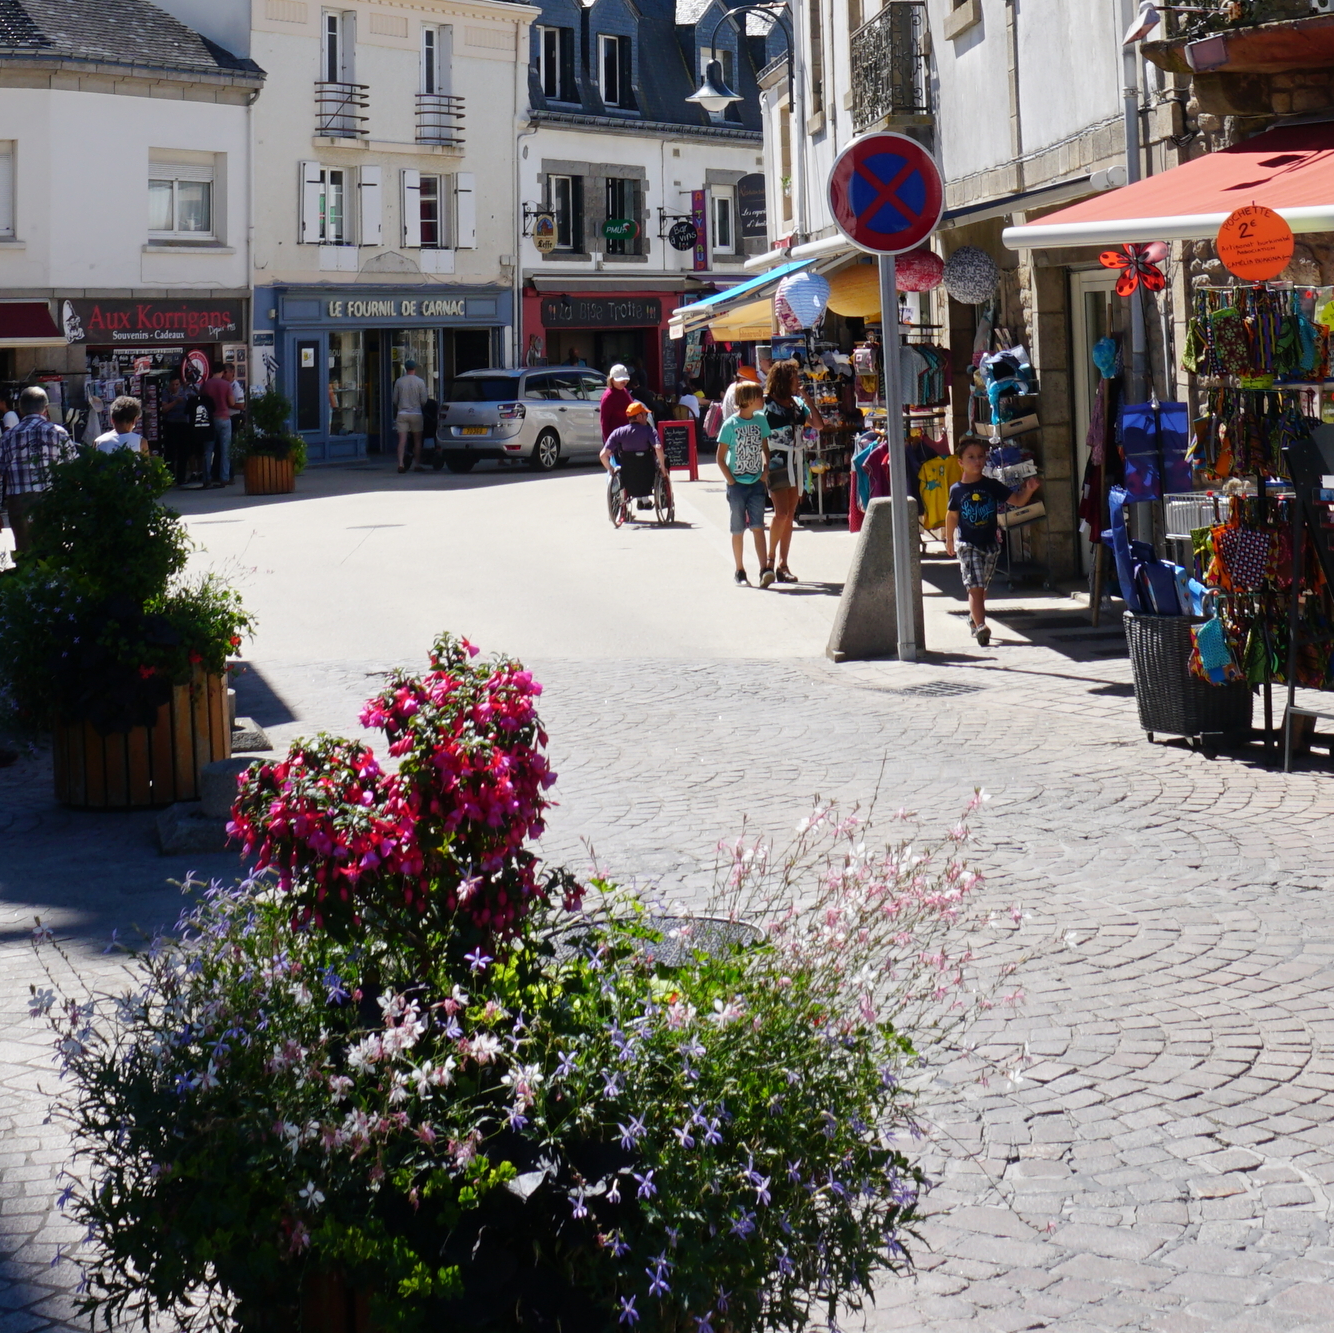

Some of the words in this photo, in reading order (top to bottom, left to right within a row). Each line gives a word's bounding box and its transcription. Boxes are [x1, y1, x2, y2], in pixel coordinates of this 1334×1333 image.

[1222, 206, 1272, 231] POCHETTE
[673, 224, 688, 235] Bar
[1238, 219, 1257, 239] 2€
[679, 231, 697, 242] vins
[537, 240, 553, 249] Leffe
[328, 301, 343, 318] LE
[347, 300, 397, 317] FOURNIL
[401, 300, 417, 317] DE
[422, 299, 465, 317] CARNAC
[88, 305, 131, 329] Aux
[136, 304, 231, 337] Korrigans
[112, 330, 149, 340] Souvenirs
[154, 330, 185, 339] Cadeaux
[734, 424, 760, 439] RULES
[735, 435, 762, 447] WERE
[734, 444, 763, 457] MADE
